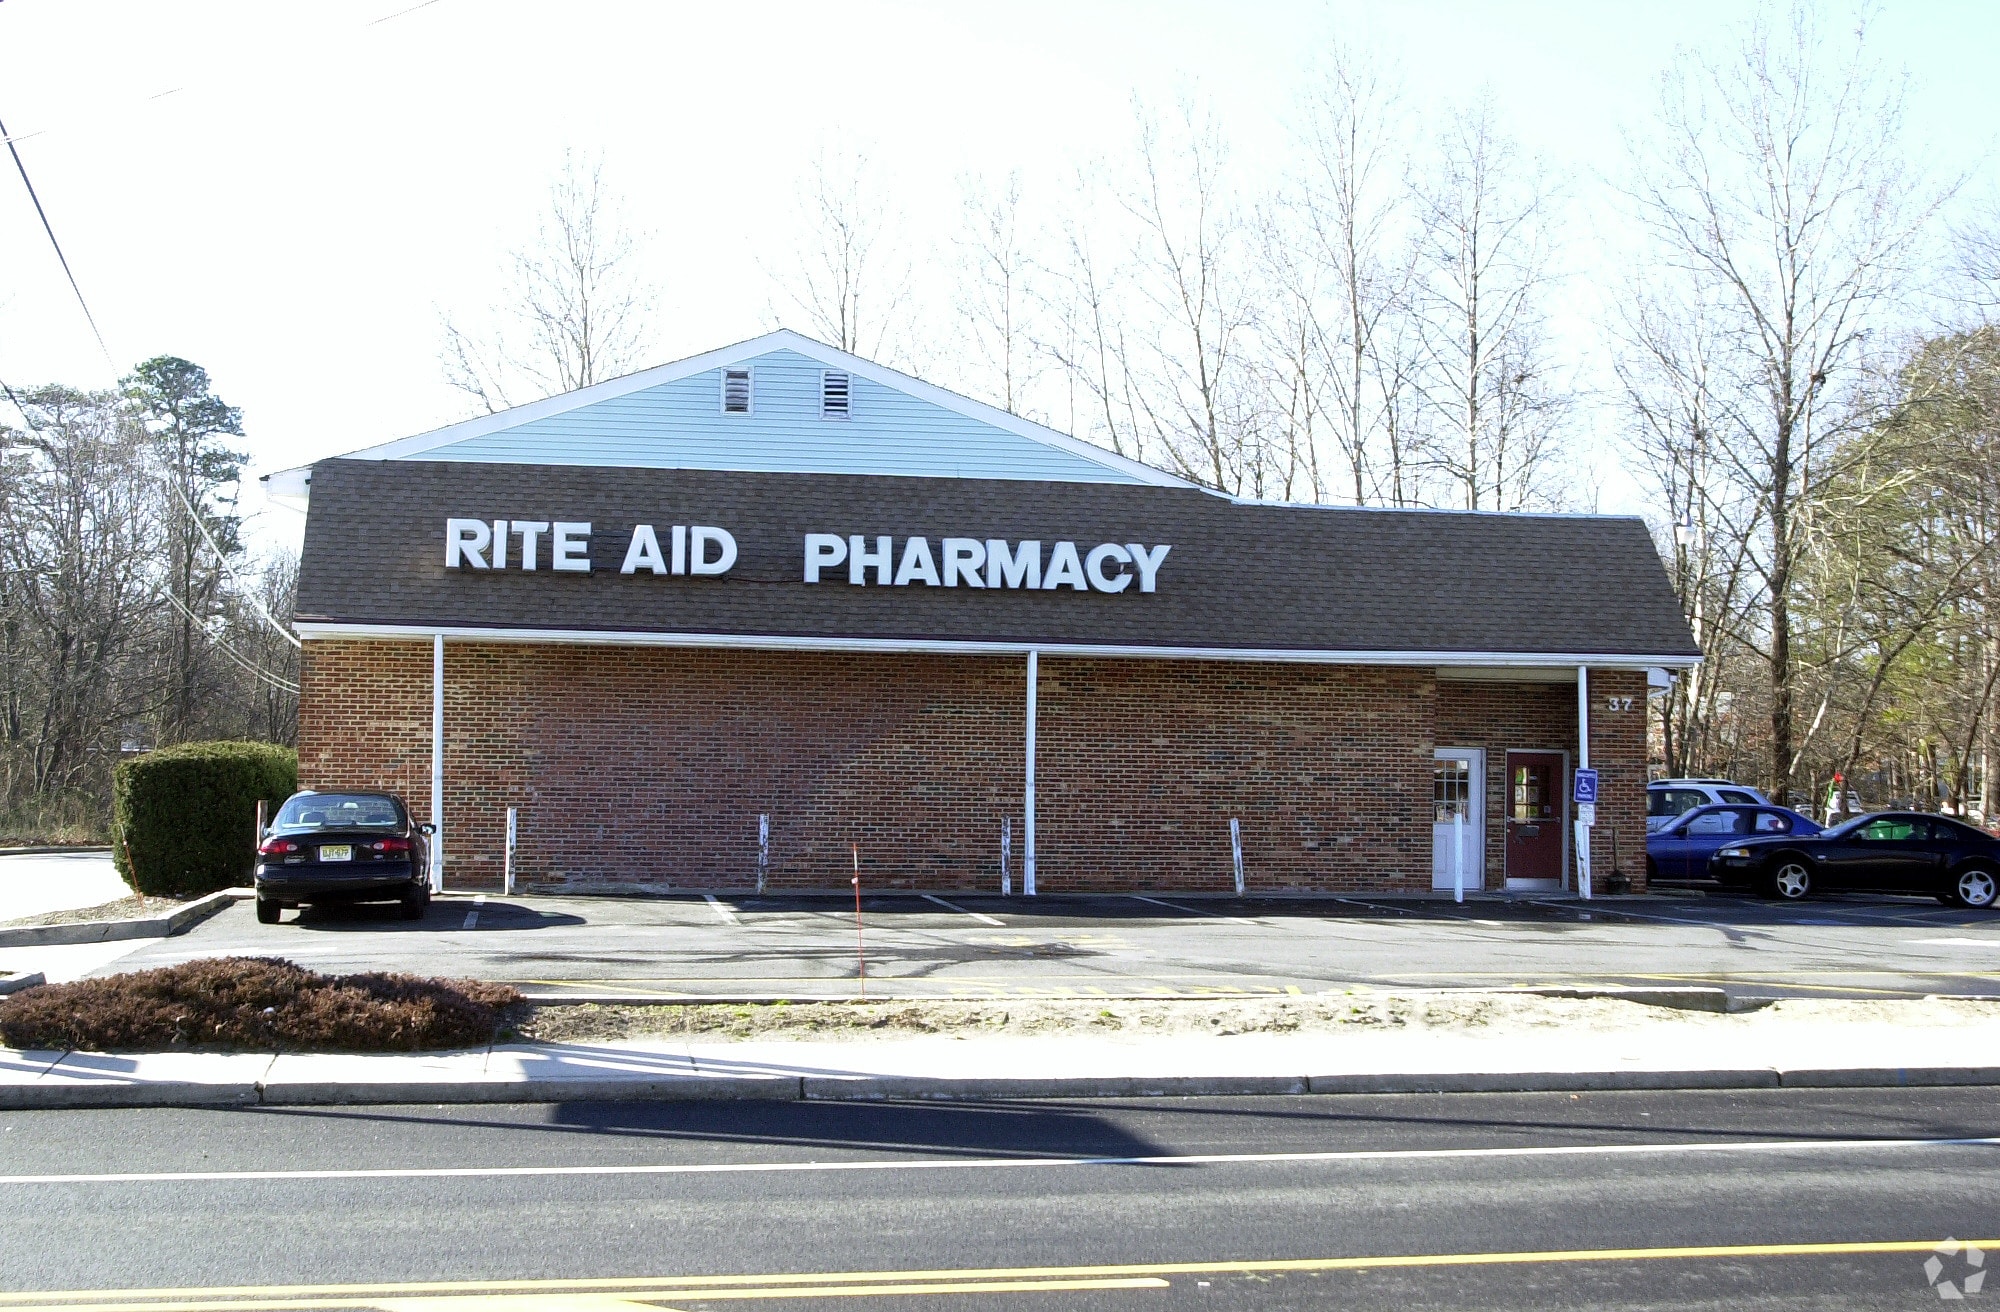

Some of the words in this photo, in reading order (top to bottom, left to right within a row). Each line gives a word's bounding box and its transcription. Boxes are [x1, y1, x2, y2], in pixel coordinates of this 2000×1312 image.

[446, 518, 592, 571] RITE
[620, 525, 737, 576] AID
[803, 533, 1171, 594] PHARMACY
[1609, 698, 1632, 712] 37
